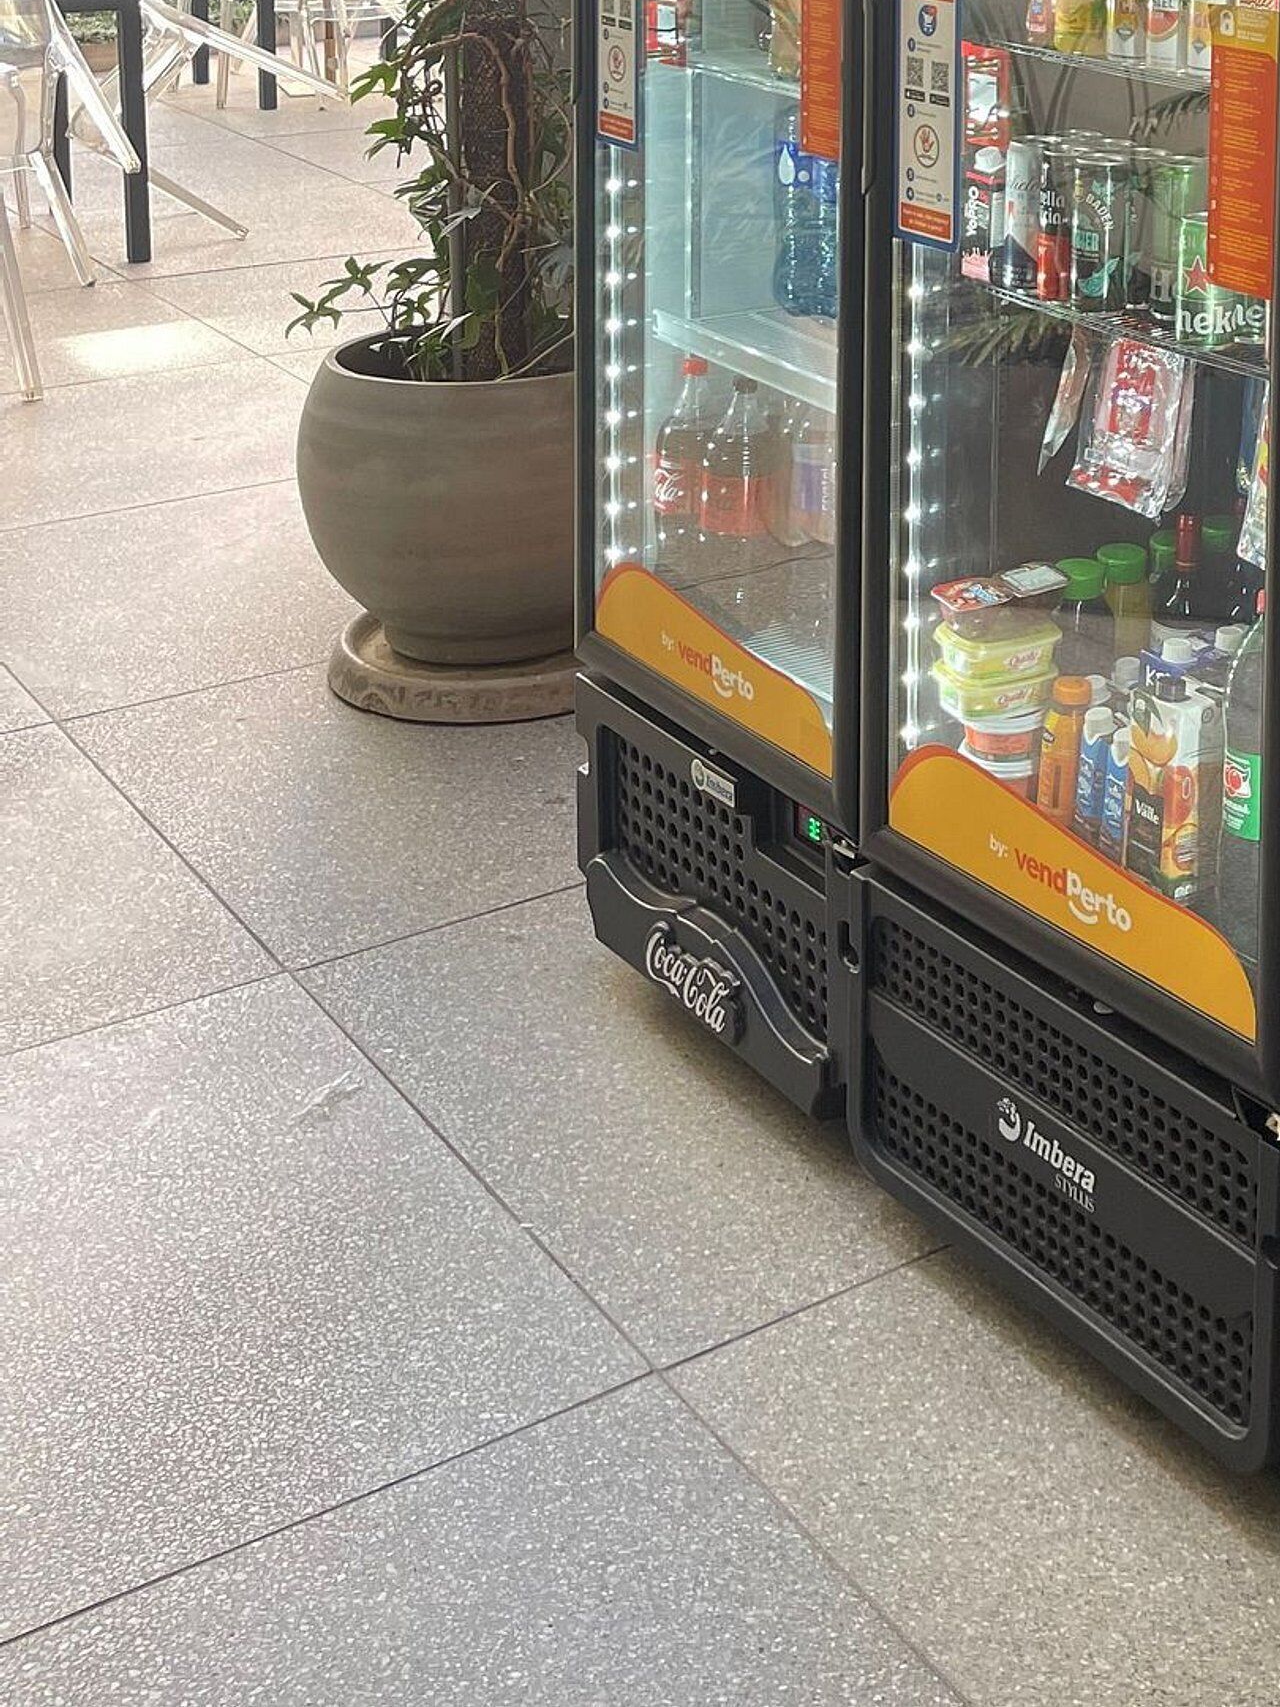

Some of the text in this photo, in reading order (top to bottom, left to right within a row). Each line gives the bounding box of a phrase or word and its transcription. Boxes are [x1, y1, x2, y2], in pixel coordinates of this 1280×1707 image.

[989, 832, 1009, 859] by:
[645, 930, 742, 1034] Coca-Cola
[1022, 1120, 1097, 1194] Imbera
